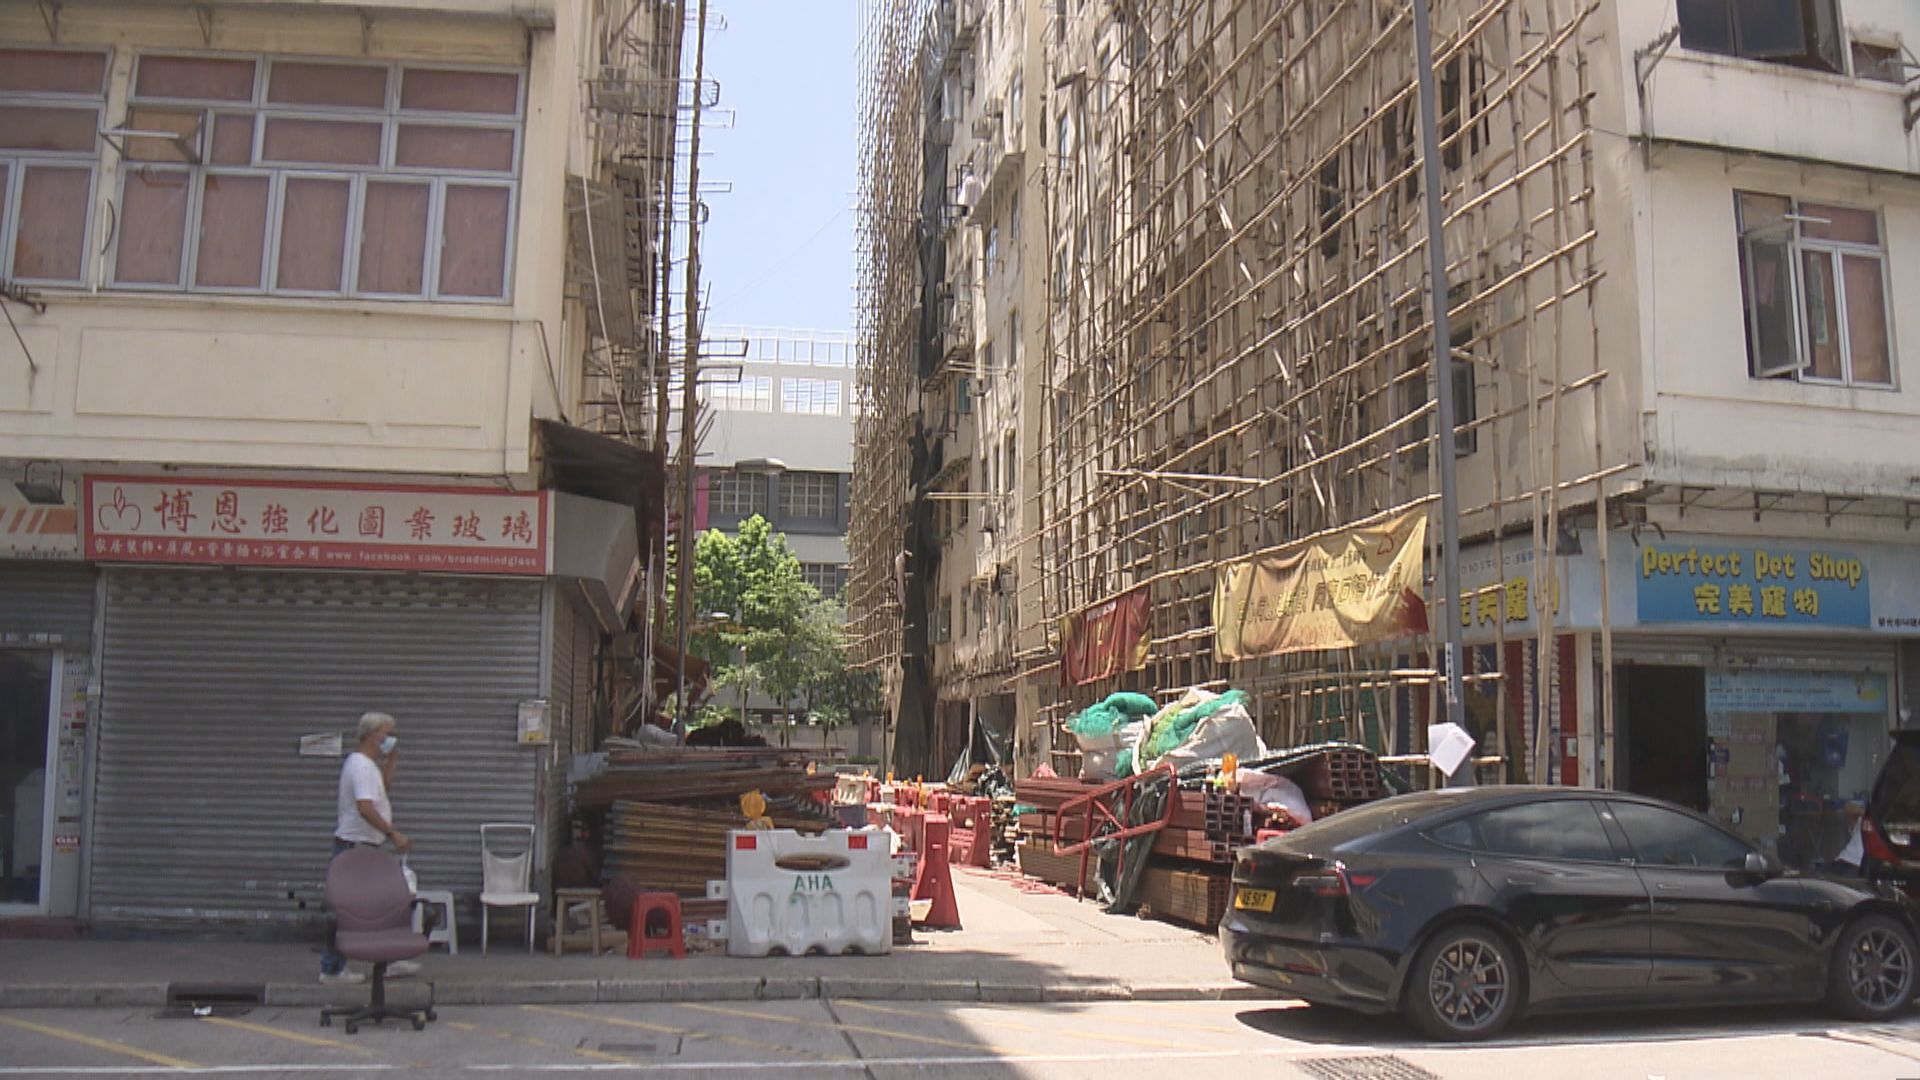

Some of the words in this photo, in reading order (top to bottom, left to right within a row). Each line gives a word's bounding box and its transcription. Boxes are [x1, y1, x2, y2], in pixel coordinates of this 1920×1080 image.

[1642, 546, 1742, 578] Perfect
[1753, 549, 1795, 580] Pet
[1808, 552, 1863, 588] Shop
[1693, 582, 1820, 618] 完美寵物
[794, 873, 834, 891] AHA
